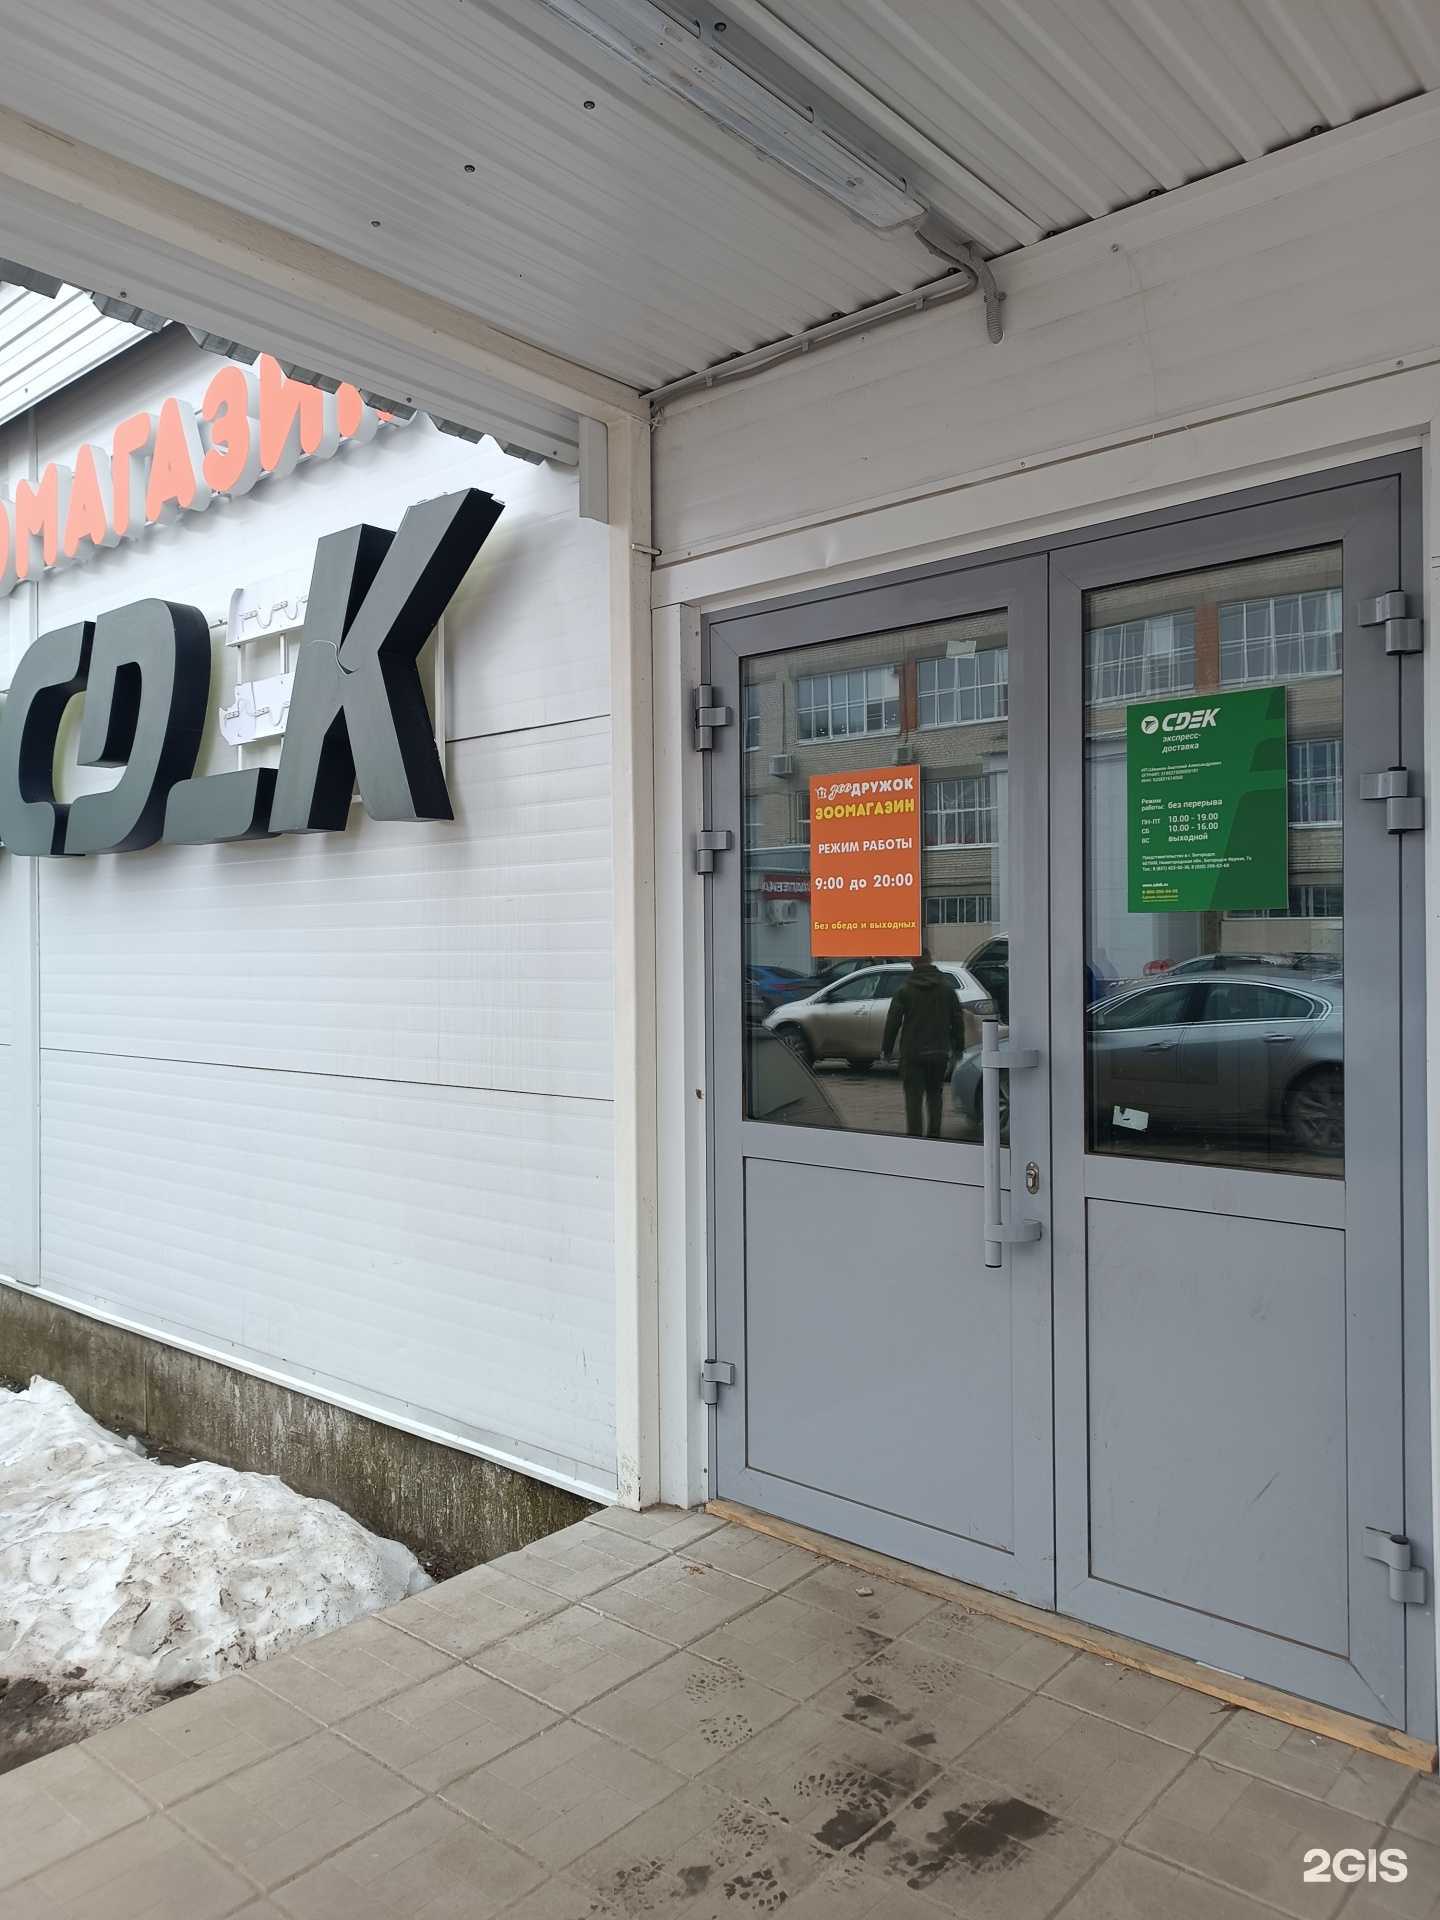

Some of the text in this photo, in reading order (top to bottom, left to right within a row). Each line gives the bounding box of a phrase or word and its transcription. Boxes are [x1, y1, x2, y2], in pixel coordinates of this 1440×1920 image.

[0, 352, 394, 590] МАГАЗИ
[1161, 743, 1200, 754] доставка
[815, 798, 915, 820] ЗООМАГАЗИН
[1168, 799, 1223, 810] без перерыва
[1168, 814, 1190, 823] 10.00
[1197, 812, 1219, 821] 19.00
[1168, 824, 1190, 833] 10.00
[1197, 822, 1219, 831] 16.00
[1168, 833, 1208, 843] выходной
[818, 837, 913, 854] РЕЖИМ РАБОТЫ
[815, 876, 844, 890] 9:00
[849, 878, 867, 891] до
[873, 873, 913, 888] 20:00
[814, 921, 829, 930] Без
[831, 921, 858, 930] обеда
[869, 920, 916, 930] выходных
